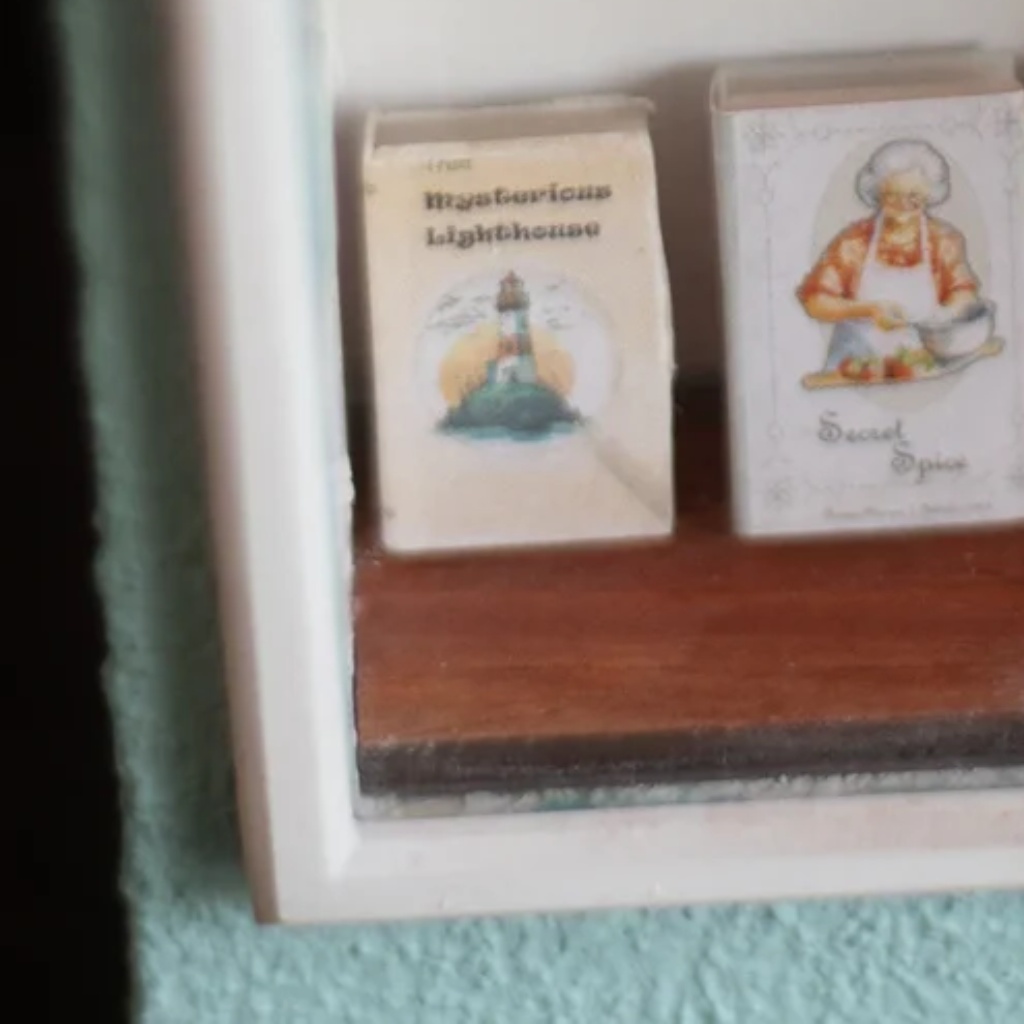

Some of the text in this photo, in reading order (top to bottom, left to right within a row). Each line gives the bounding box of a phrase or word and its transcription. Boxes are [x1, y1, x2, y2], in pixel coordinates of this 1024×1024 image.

[424, 182, 612, 211] Mysterious
[426, 222, 600, 249] Lighthouse
[817, 410, 905, 443] Secret
